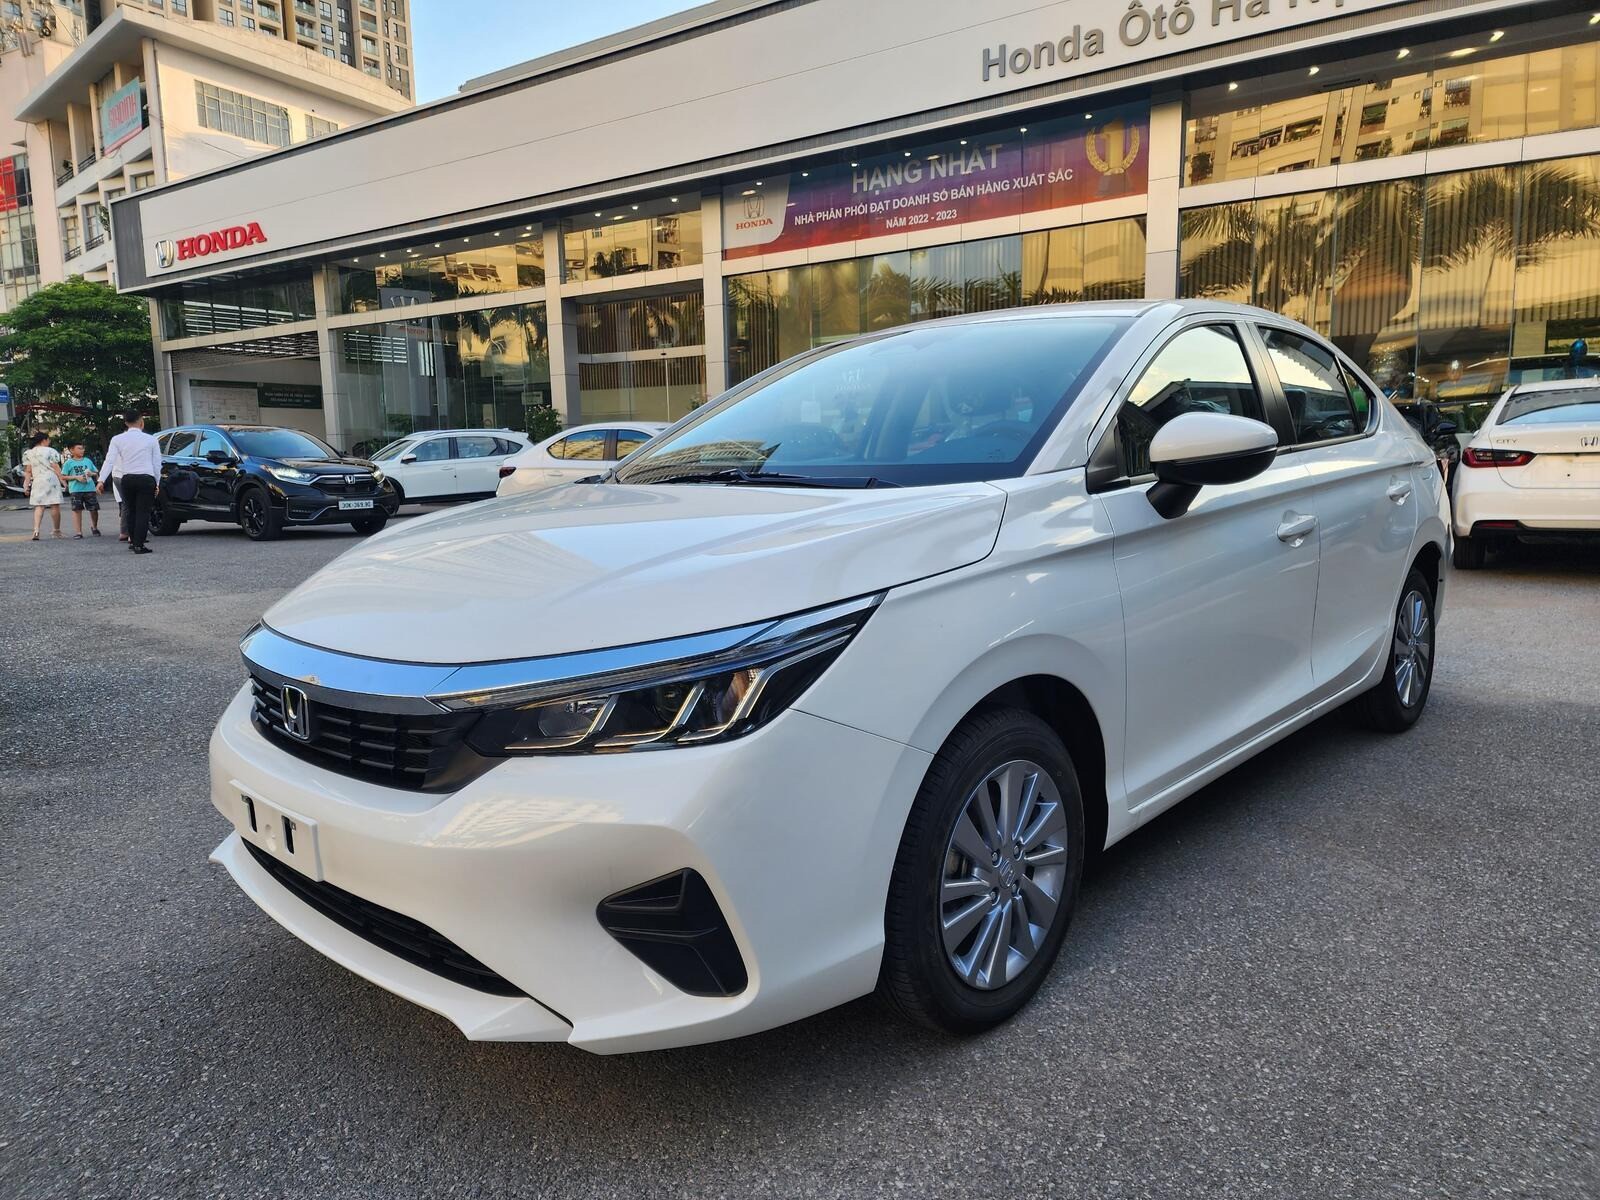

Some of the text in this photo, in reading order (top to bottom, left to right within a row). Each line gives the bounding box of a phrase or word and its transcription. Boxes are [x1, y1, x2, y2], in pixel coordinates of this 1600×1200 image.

[982, 25, 1105, 81] Honda
[1119, 0, 1195, 46] Ôtô
[853, 159, 922, 195] HẠNG
[794, 211, 815, 225] NHÀ
[869, 200, 891, 214] ĐẠT
[892, 193, 930, 209] DOANH
[950, 184, 974, 200] BÁN
[976, 180, 1010, 195] HÀNG
[886, 216, 907, 229] NĂM
[908, 213, 929, 225] 2022
[936, 209, 958, 221] 2023
[176, 222, 267, 260] HONDA
[735, 217, 773, 231] HONDA
